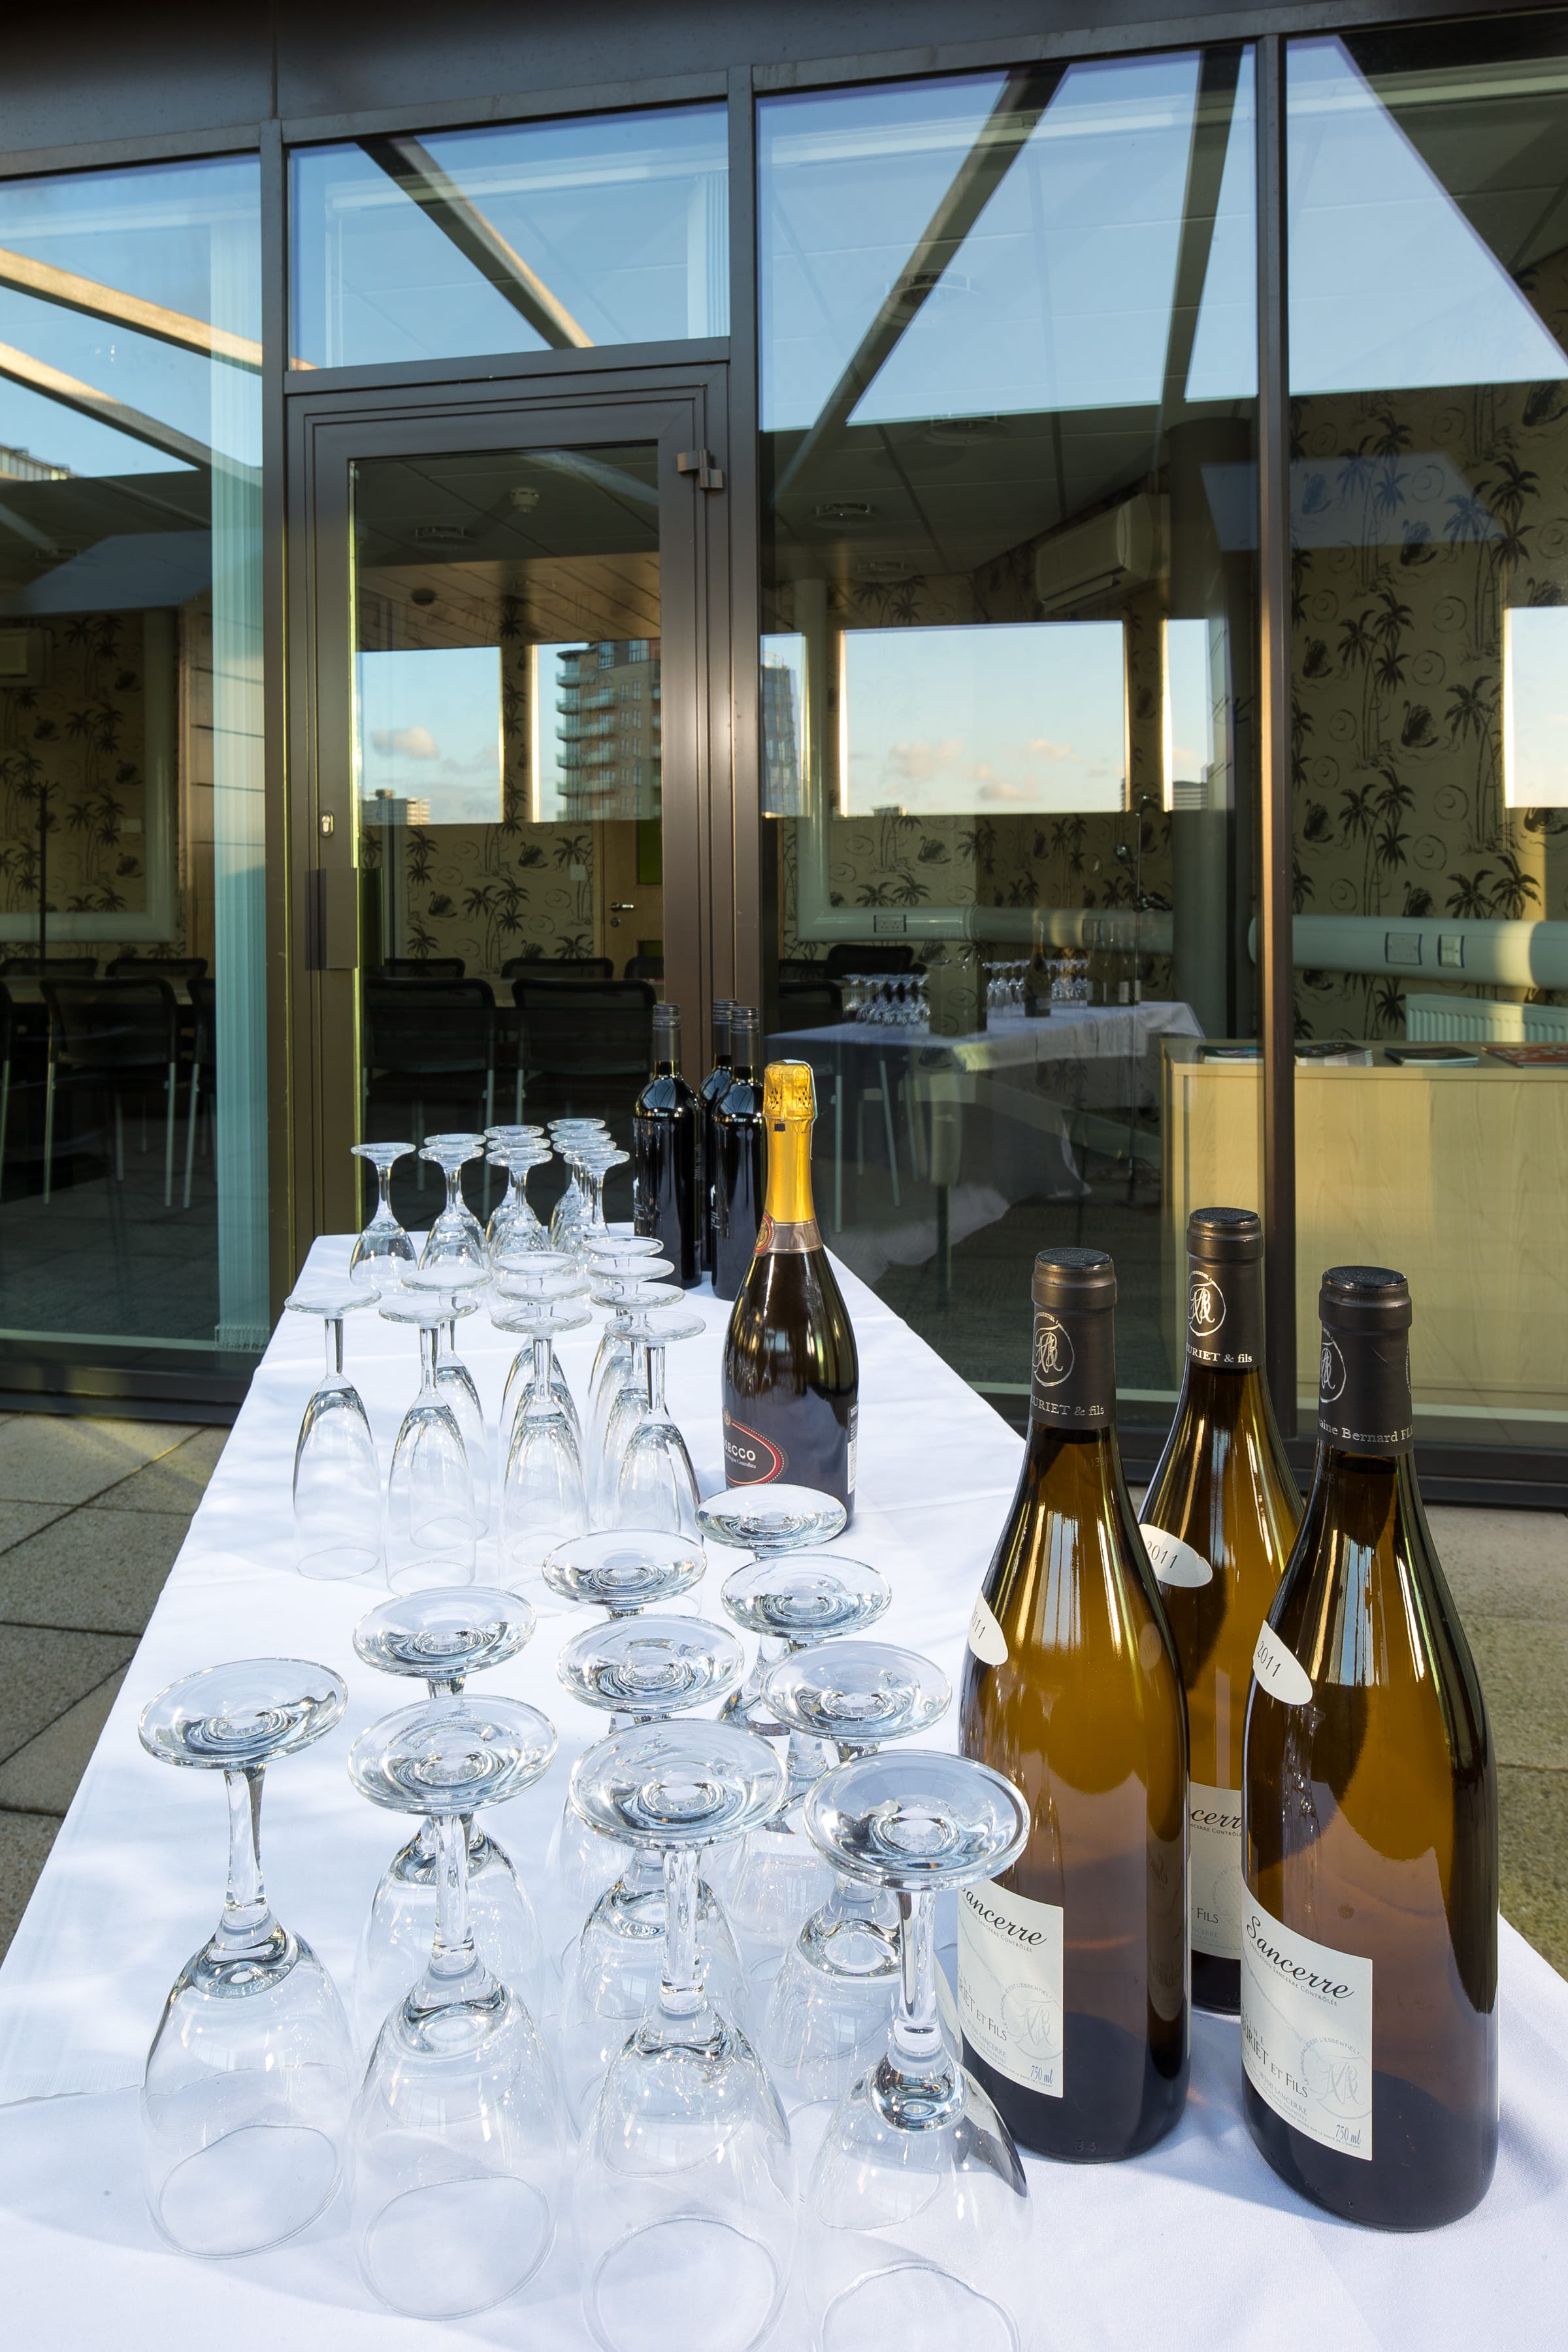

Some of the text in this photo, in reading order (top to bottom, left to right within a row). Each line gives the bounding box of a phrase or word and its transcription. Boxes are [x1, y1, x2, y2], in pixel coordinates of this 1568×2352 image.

[1224, 1354, 1234, 1363] &
[1237, 1353, 1252, 1364] fils
[1074, 1406, 1086, 1416] &
[1088, 1405, 1105, 1416] fils
[1341, 1427, 1399, 1443] Bernard
[971, 1605, 986, 1640] 011
[1257, 1641, 1281, 1678] 2011
[960, 1887, 1048, 1946] ancerre
[1196, 1906, 1219, 1924] FILS
[1246, 1916, 1355, 1999] Sancerre
[1273, 1965, 1299, 1989] SANCERRE
[1300, 1985, 1338, 2007] CONTRÔLÉE
[976, 2009, 987, 2025] ET
[988, 2017, 1007, 2041] FILS
[1030, 2065, 1054, 2084] 750 ml
[1271, 2062, 1283, 2080] ET
[1286, 2072, 1308, 2099] FILS
[1335, 2124, 1362, 2145] 750 ml
